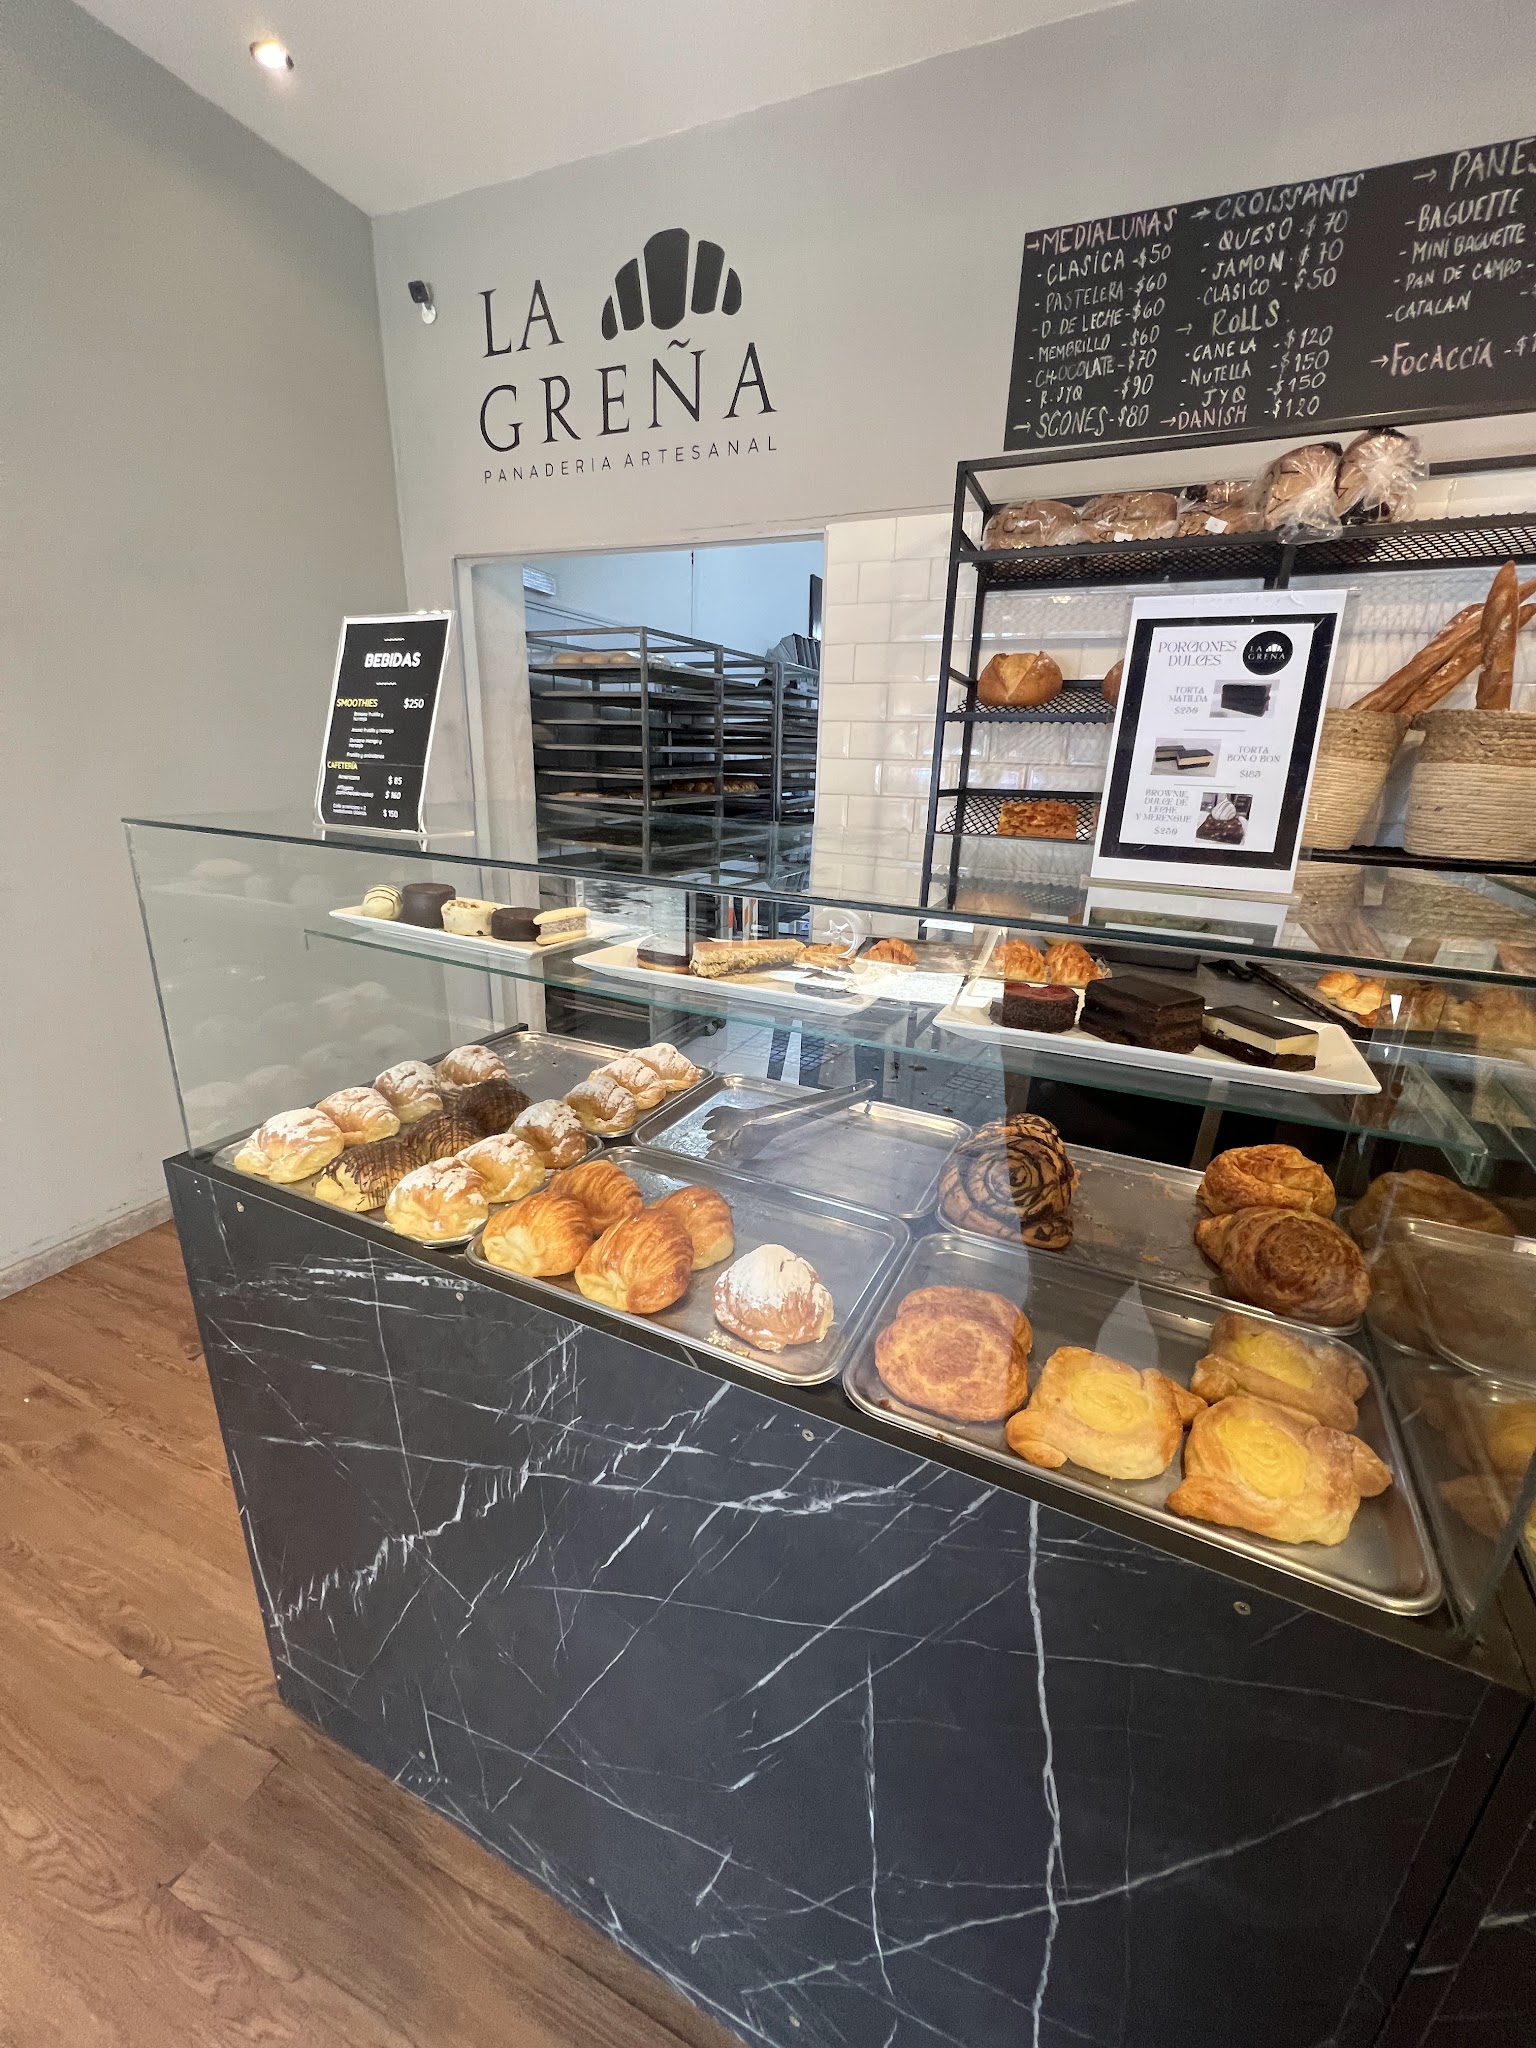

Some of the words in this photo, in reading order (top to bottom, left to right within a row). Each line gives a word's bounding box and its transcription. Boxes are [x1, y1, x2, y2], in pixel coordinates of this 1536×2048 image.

[1215, 173, 1364, 221] CROISSANTS
[1418, 188, 1524, 233] BAGUETTE
[1041, 207, 1177, 255] MEDIALUNAS
[1219, 216, 1293, 251] QUESO
[1412, 233, 1452, 264] MINI
[1454, 223, 1526, 257] BAGUETTE
[1047, 249, 1125, 286] CLASICA
[1212, 249, 1284, 281] JAMON
[1406, 270, 1435, 291] PAN
[1443, 264, 1465, 284] DE
[1472, 258, 1522, 281] CAMPO
[1046, 279, 1123, 313] PASTELERA
[1203, 278, 1270, 306] CLASICO
[1394, 290, 1471, 322] CATALAN
[478, 279, 565, 358] LA
[1060, 317, 1077, 335] DE
[1082, 308, 1122, 333] LECHE
[1212, 299, 1280, 337] ROLLS
[1039, 334, 1110, 363] MEMBRILLO
[1193, 337, 1257, 363] CANELA
[1390, 338, 1493, 376] FOCACCIA
[1035, 355, 1115, 388] CHOCOLATE
[1190, 359, 1251, 387] NUTELLA
[480, 338, 777, 452] GREÑA
[1035, 406, 1108, 439] SCONES
[1178, 405, 1247, 430] DANISH
[485, 457, 611, 483] PANADERIA
[624, 436, 777, 469] ARTESANAL
[364, 652, 421, 668] BEBIDAS
[1158, 640, 1237, 653] PORCIONES
[1168, 654, 1222, 667] DULCES
[336, 698, 378, 708] SMOOTHIES
[403, 697, 425, 710] $250
[1168, 694, 1208, 703] MATILDA
[1175, 686, 1205, 694] TORTA
[1227, 754, 1247, 763] BON
[1260, 755, 1281, 763] BON
[1238, 746, 1269, 755] TORTA
[1144, 797, 1174, 806] DULCE
[1175, 798, 1189, 807] DE
[1148, 806, 1178, 814] LECHE
